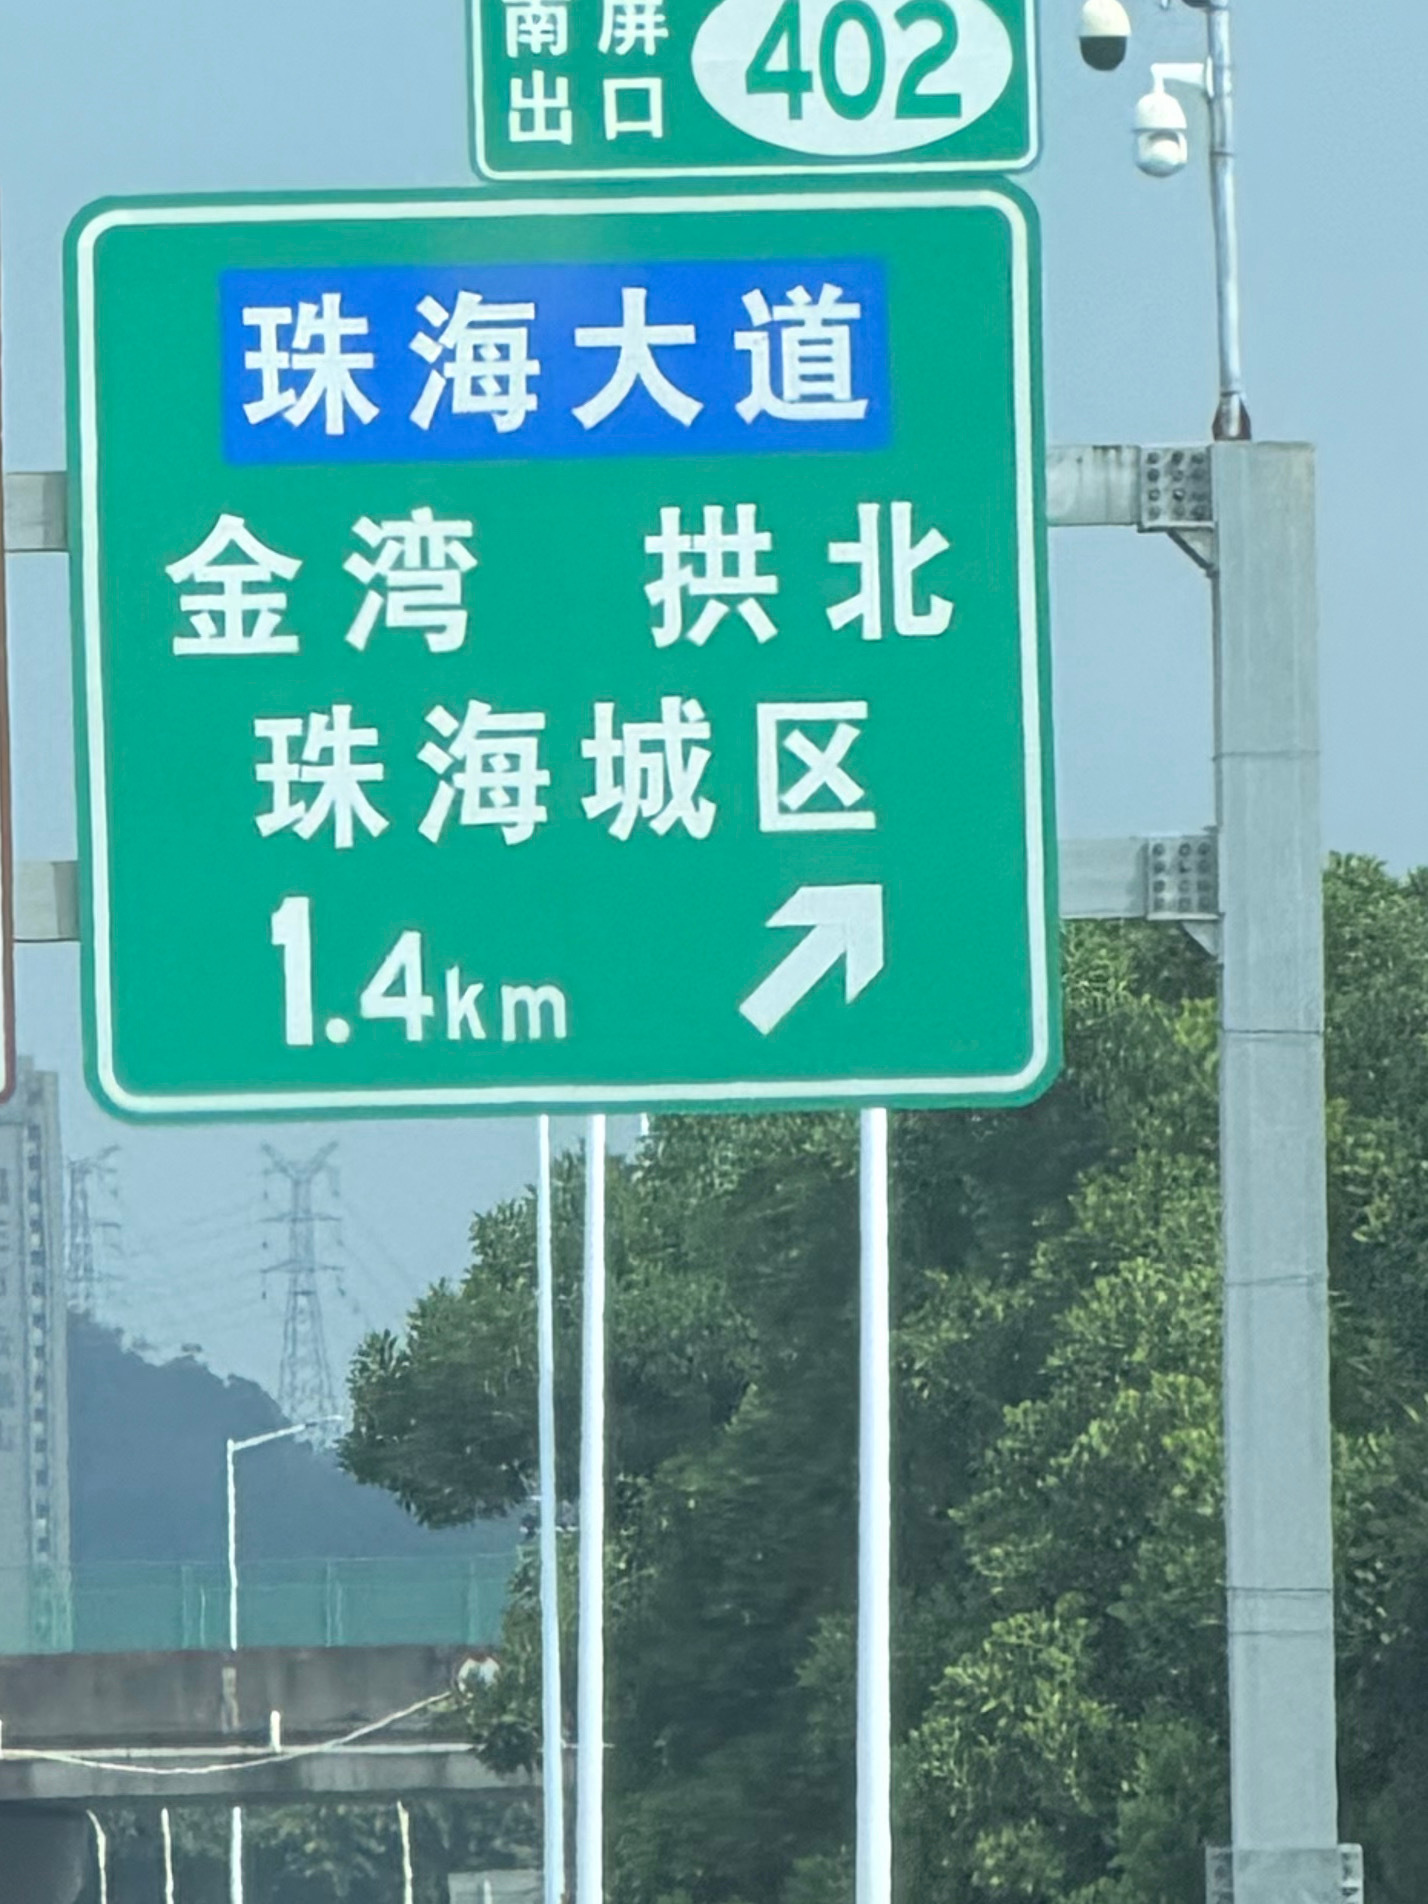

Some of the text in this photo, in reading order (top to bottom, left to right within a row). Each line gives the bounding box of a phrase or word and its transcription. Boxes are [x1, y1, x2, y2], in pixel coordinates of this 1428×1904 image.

[507, 69, 664, 145] 出口
[242, 283, 868, 435] 珠海大道
[165, 501, 954, 655] 金湾 拱北
[254, 695, 876, 849] 珠海城区
